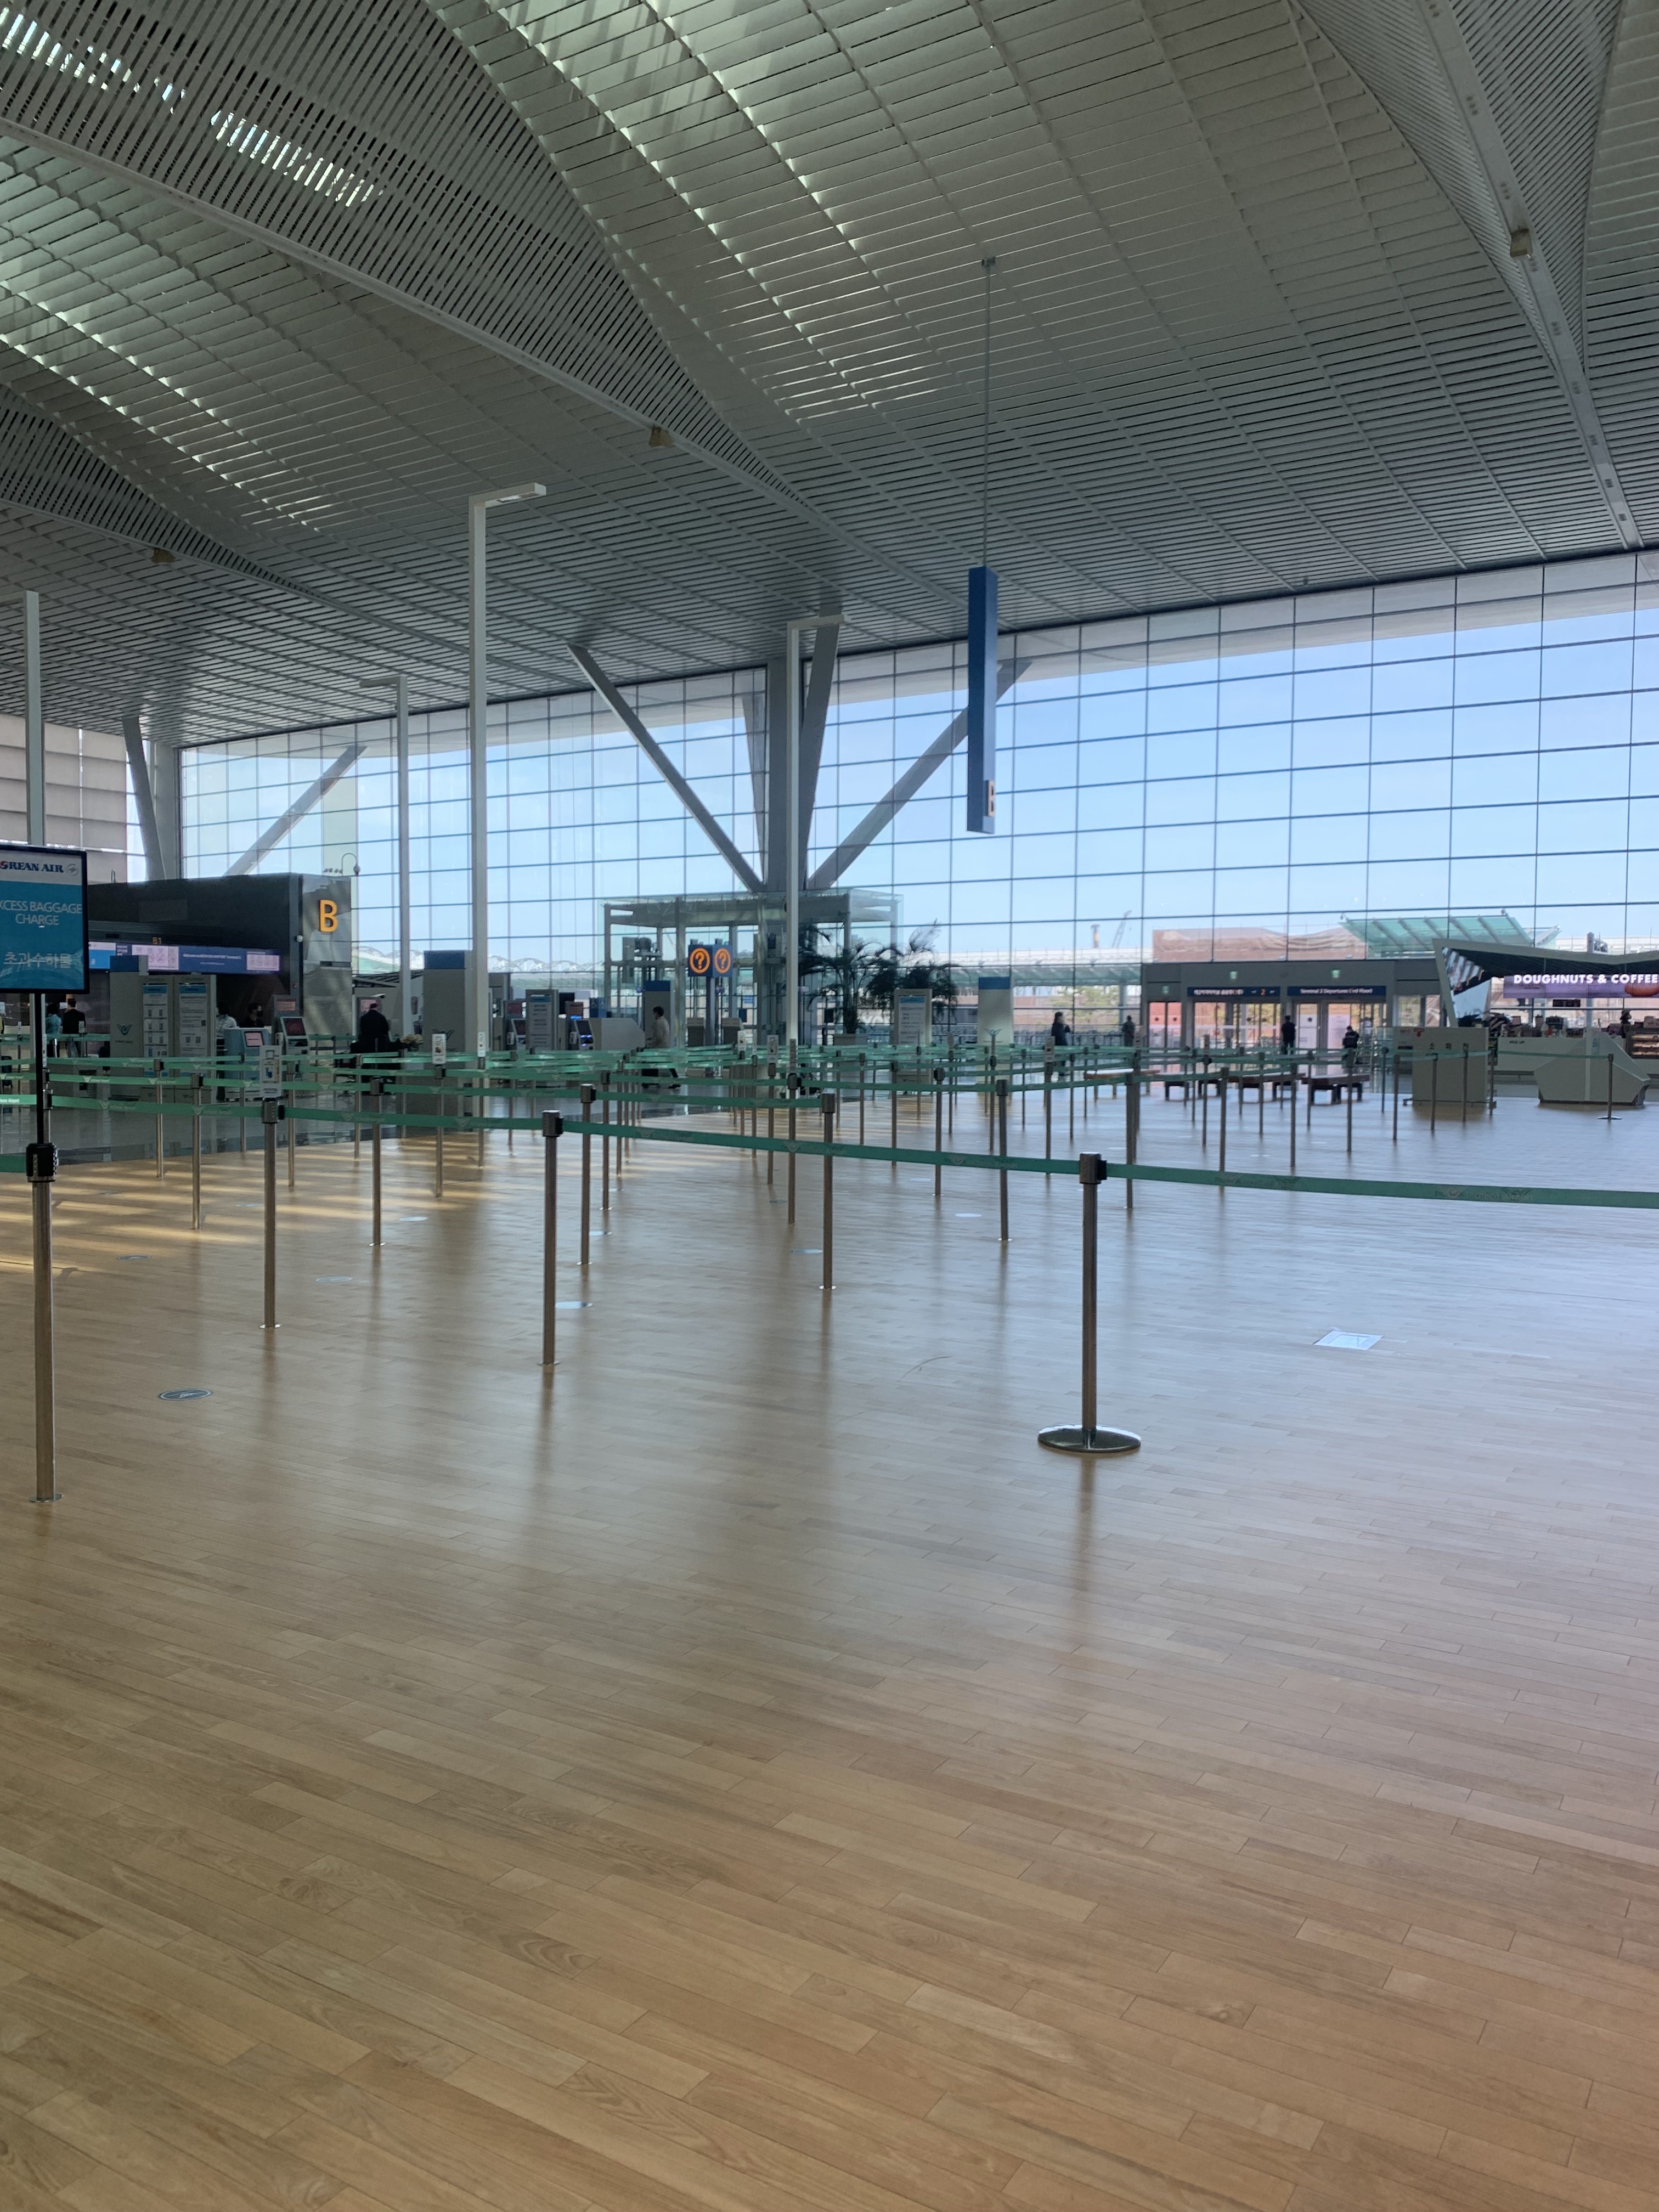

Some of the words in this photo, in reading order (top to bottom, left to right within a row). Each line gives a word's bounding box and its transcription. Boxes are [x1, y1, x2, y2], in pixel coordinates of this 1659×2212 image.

[41, 864, 64, 873] AIR
[30, 901, 82, 913] BAGGAGE
[15, 913, 60, 925] CHARGE
[319, 899, 338, 932] B
[3, 952, 72, 968] 초과수하물
[1514, 974, 1594, 984] DOUGHNUTS
[1597, 974, 1607, 983] &
[1611, 974, 1658, 984] COFFEE
